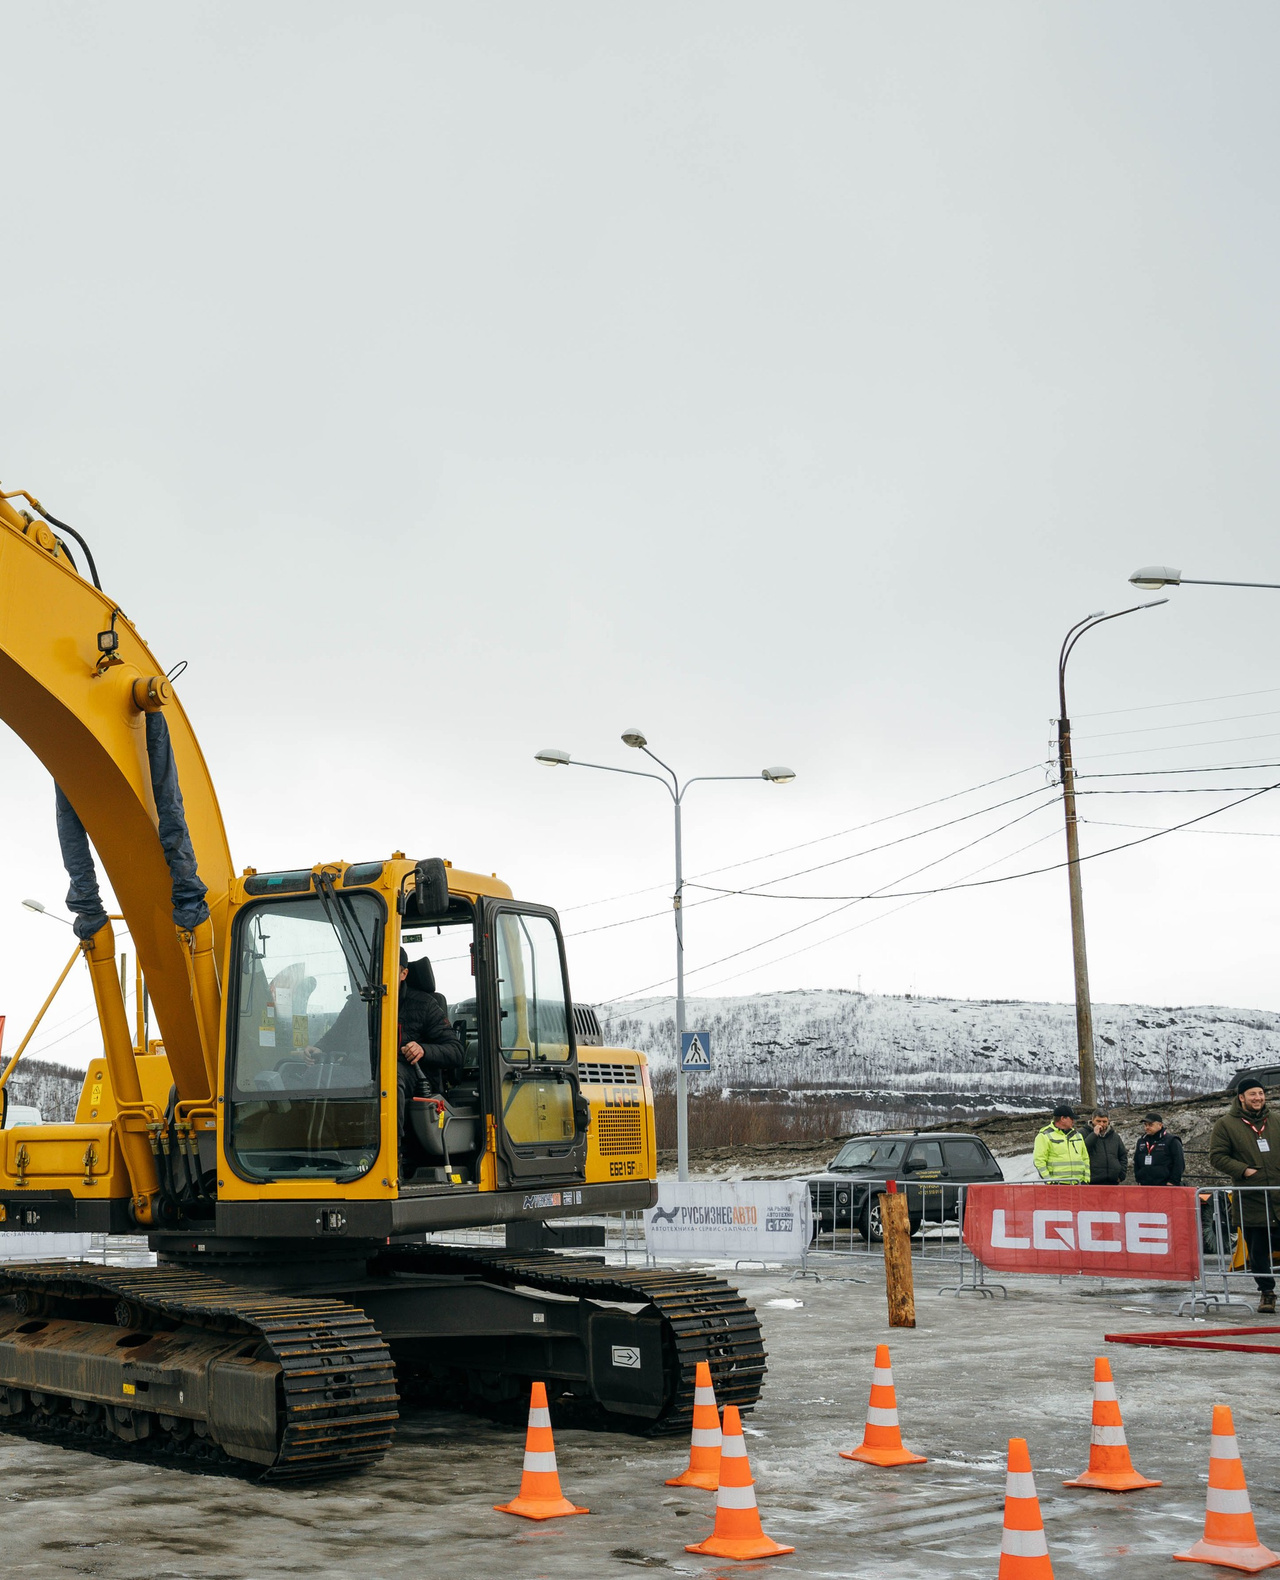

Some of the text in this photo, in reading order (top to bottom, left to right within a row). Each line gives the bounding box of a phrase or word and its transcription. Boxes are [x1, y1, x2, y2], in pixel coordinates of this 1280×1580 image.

[604, 1088, 639, 1107] LGCE
[681, 1206, 757, 1225] РУСБИЗНЕСАВТО
[991, 1209, 1168, 1255] LGCE
